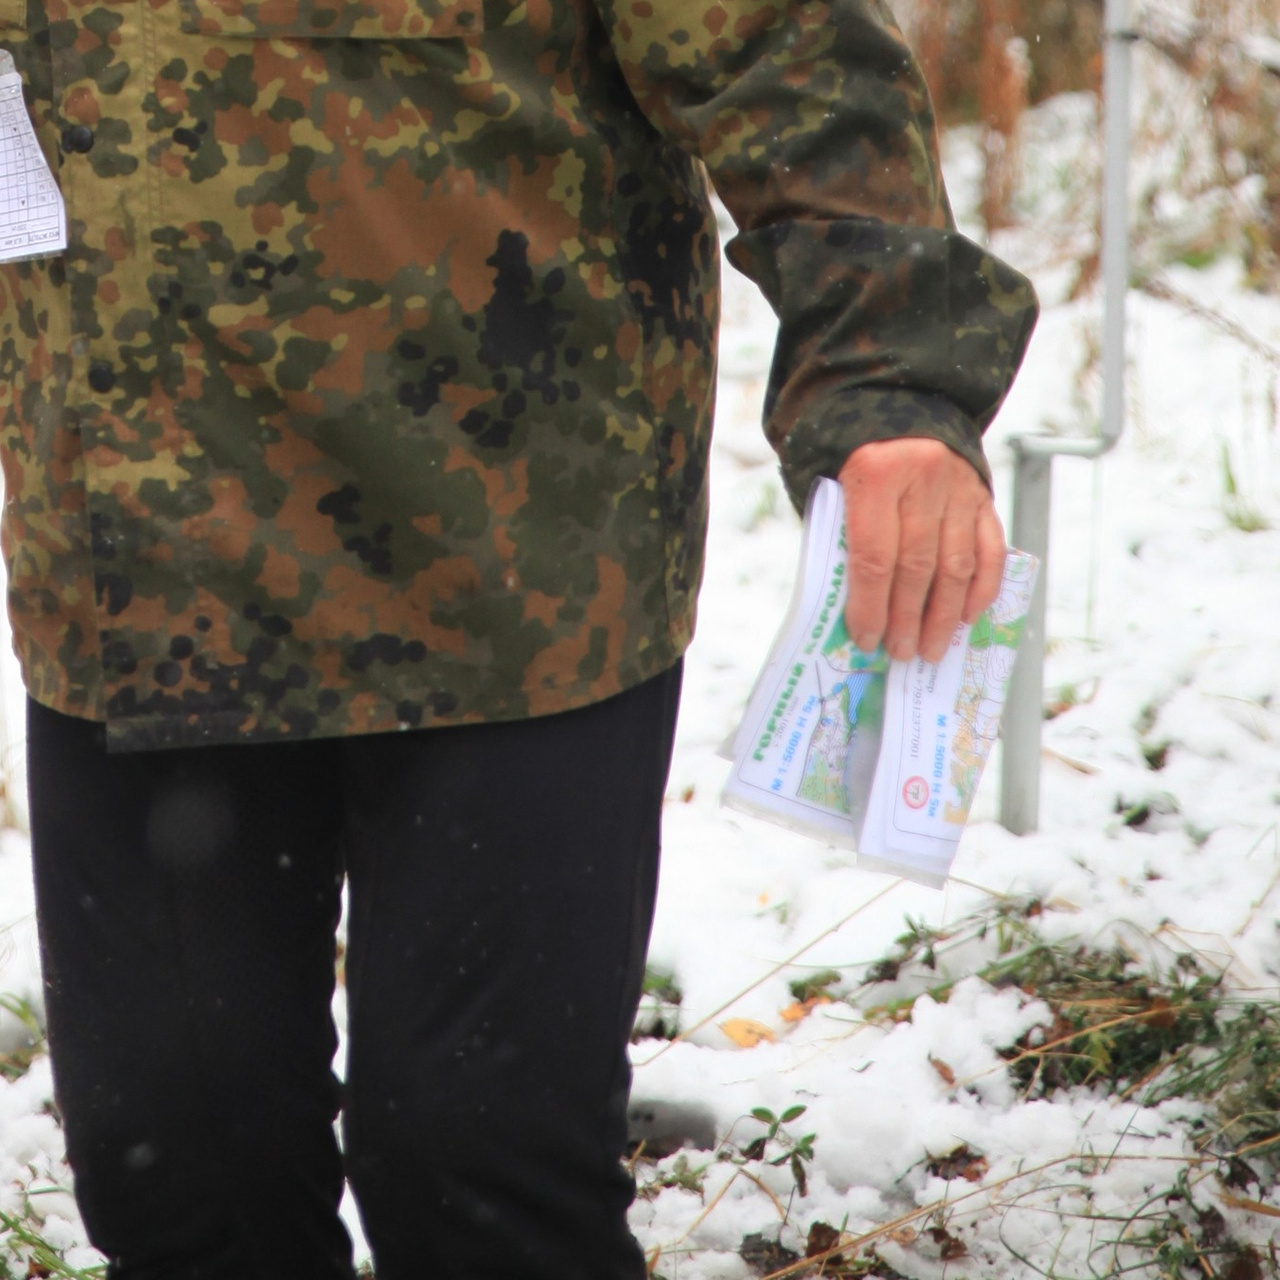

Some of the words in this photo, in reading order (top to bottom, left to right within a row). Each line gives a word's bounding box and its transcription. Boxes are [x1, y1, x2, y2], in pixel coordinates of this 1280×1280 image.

[753, 662, 806, 761] ГОРНЫЙ
[803, 561, 845, 654] КОРОЛЬ
[778, 730, 802, 774] 1:5000
[932, 732, 947, 779] 1:5000
